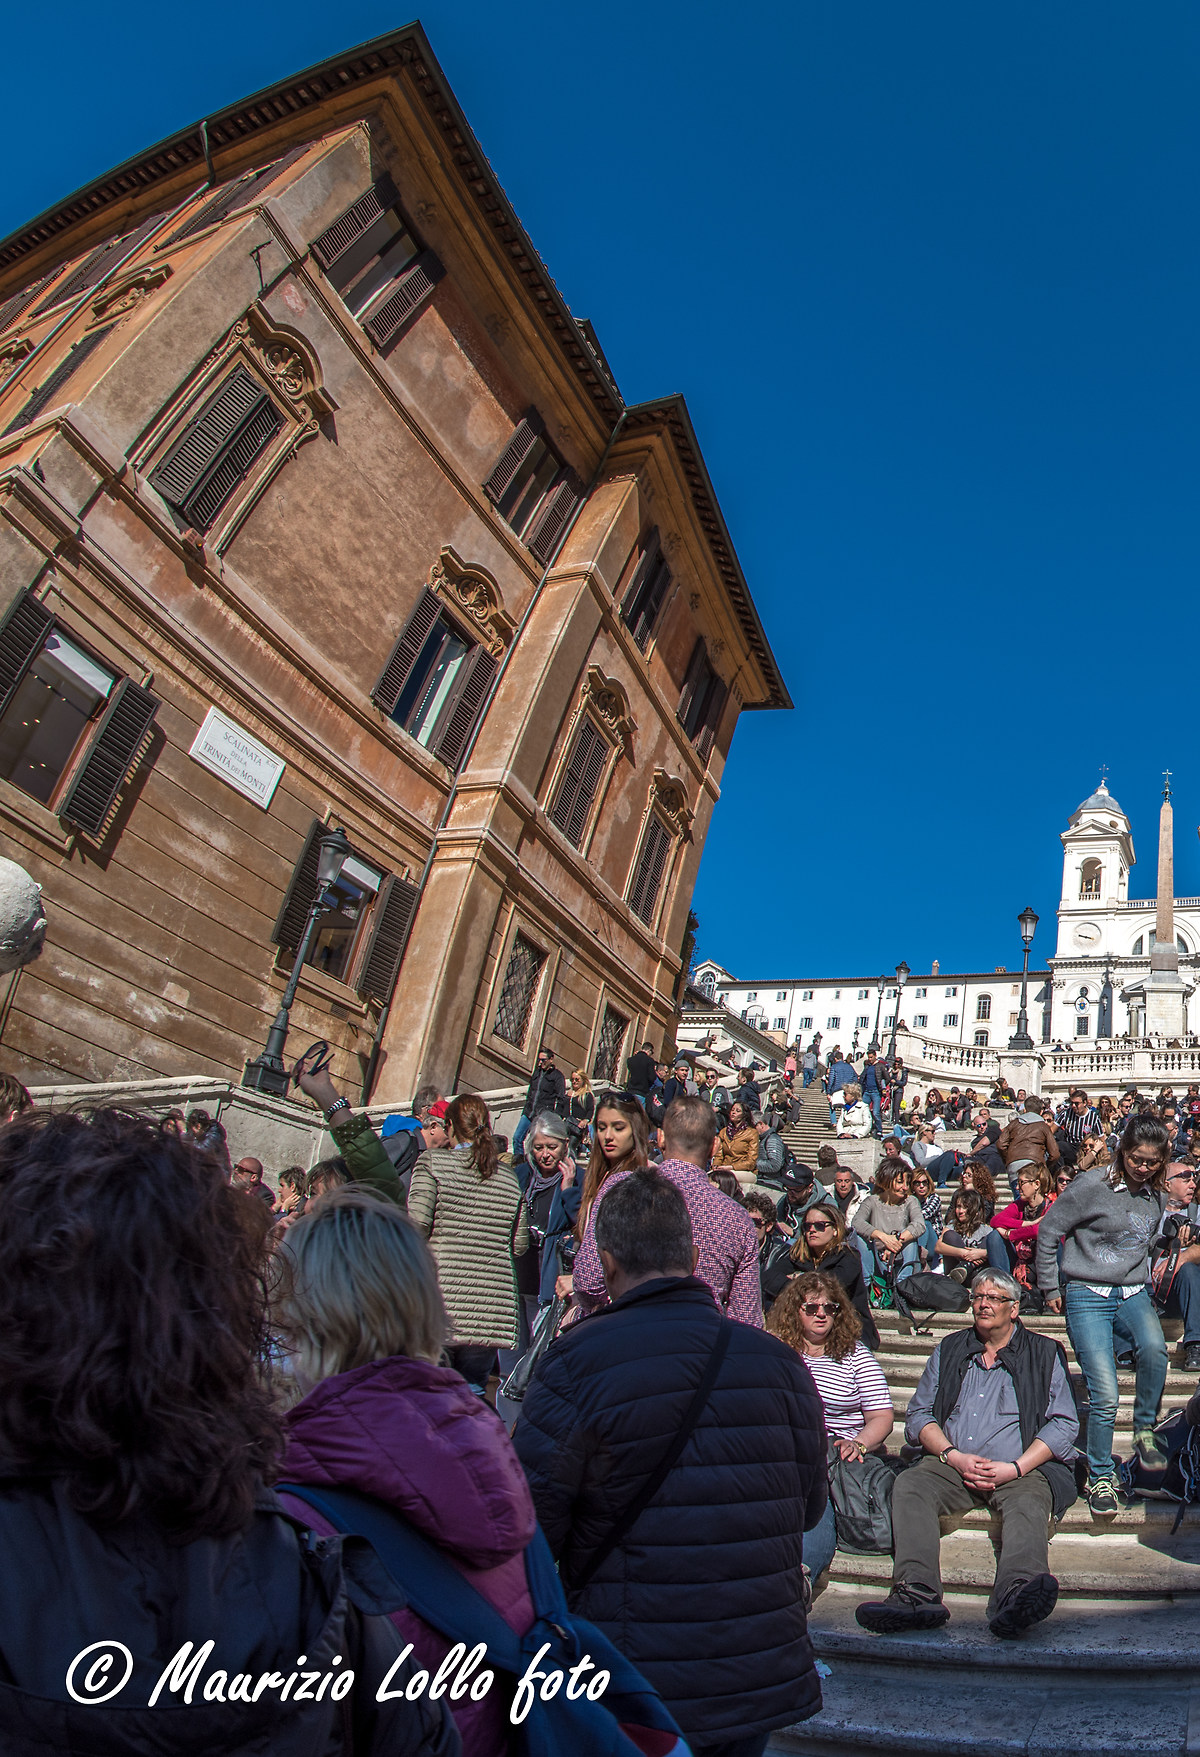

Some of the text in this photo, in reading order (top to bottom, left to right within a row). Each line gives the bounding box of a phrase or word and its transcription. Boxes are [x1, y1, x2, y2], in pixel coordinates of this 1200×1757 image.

[223, 731, 262, 766] SCALINATA
[230, 750, 247, 767] DELLA
[231, 764, 241, 774] DEI
[240, 770, 266, 793] MONTI
